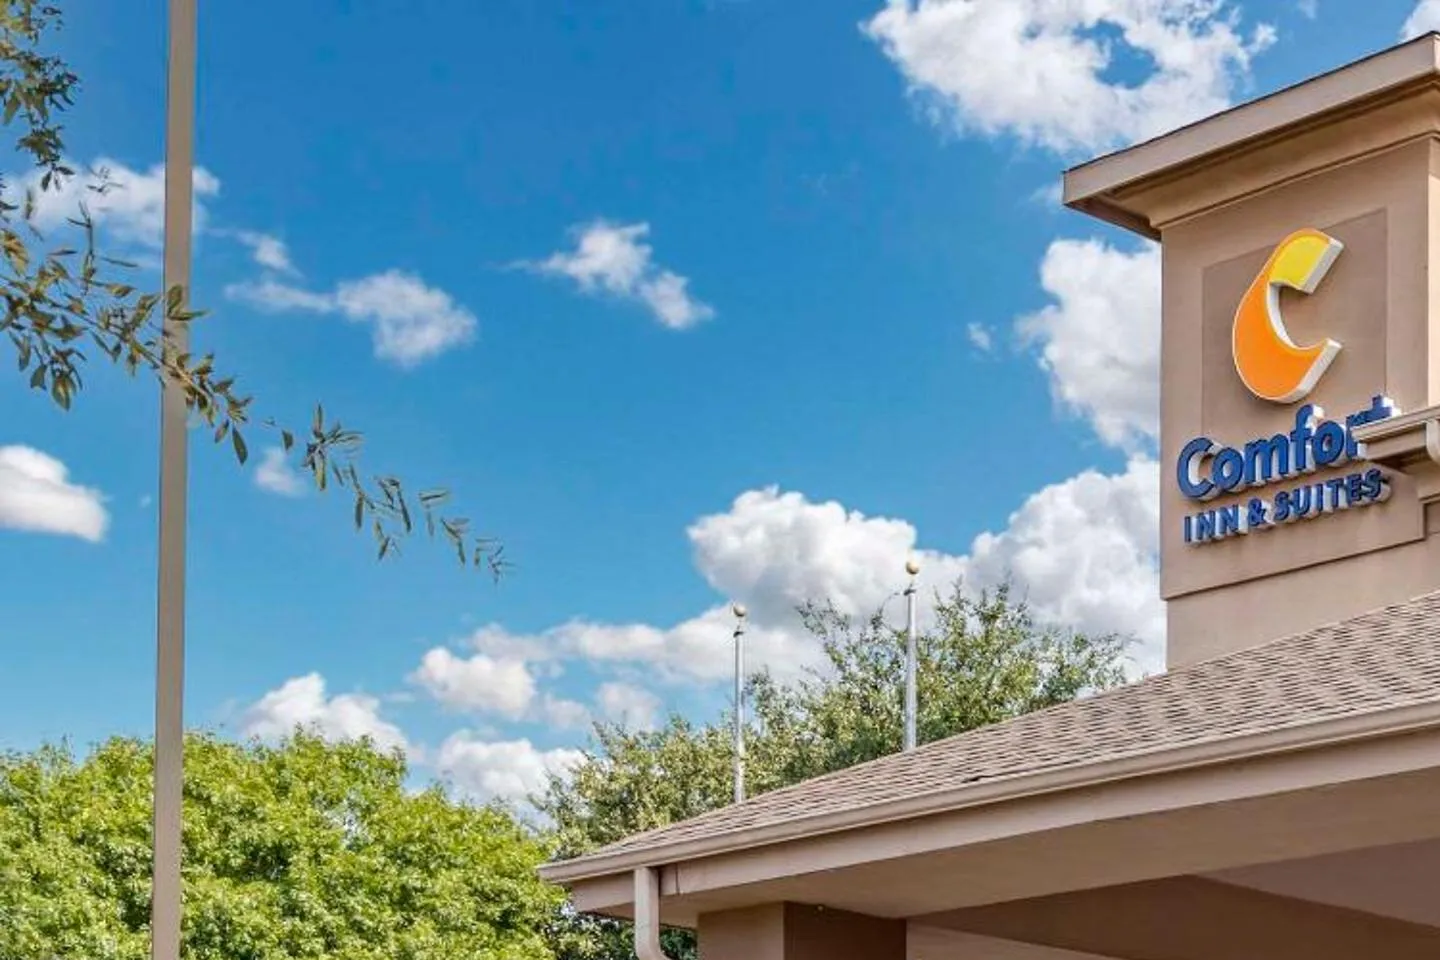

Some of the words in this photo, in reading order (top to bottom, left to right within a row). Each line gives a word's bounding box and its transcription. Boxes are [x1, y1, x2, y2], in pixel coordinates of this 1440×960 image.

[1184, 504, 1248, 544] INN
[1248, 497, 1275, 529] &
[1273, 468, 1392, 523] SUITES
